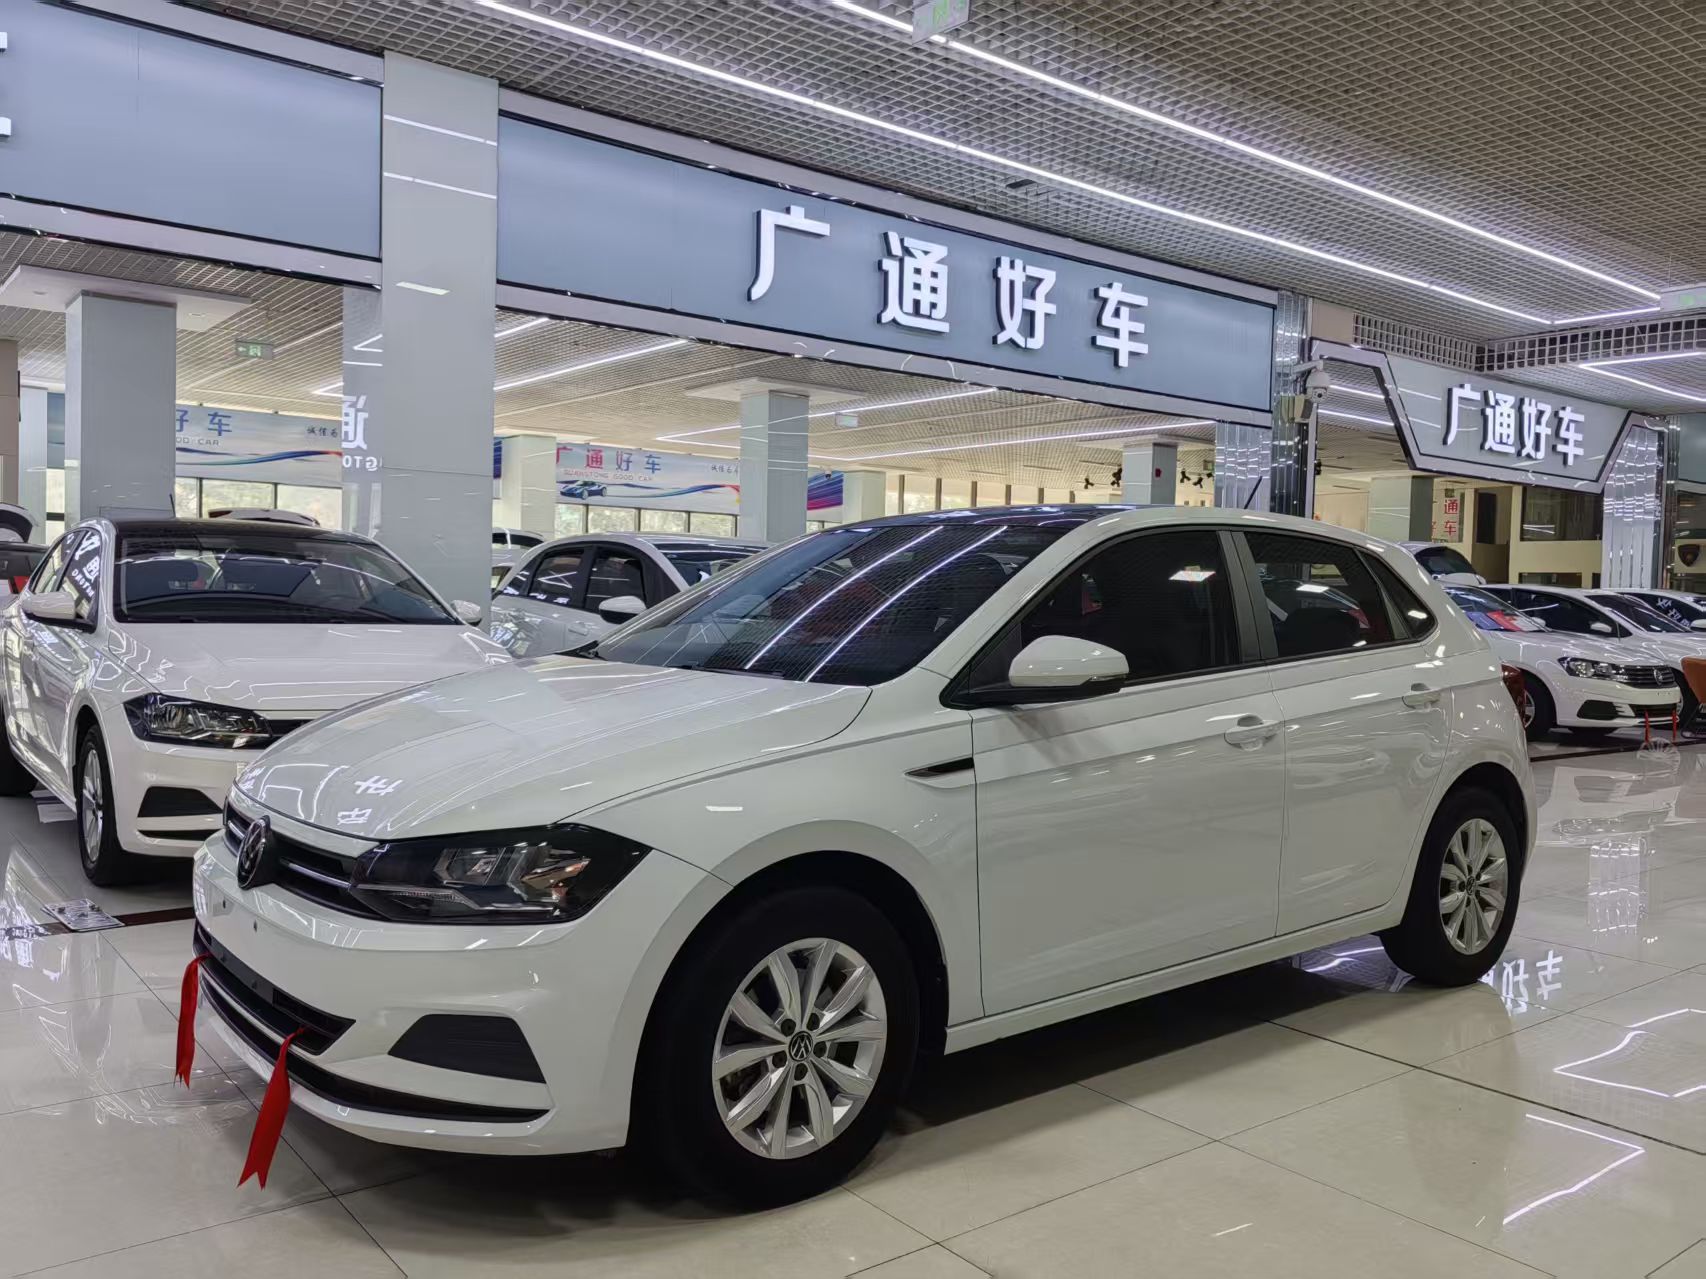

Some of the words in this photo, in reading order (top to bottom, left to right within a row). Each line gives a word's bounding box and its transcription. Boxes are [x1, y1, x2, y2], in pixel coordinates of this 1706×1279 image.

[746, 205, 1150, 368] 广通好车
[556, 446, 662, 474] 广通好车
[1444, 383, 1584, 466] 广通好车
